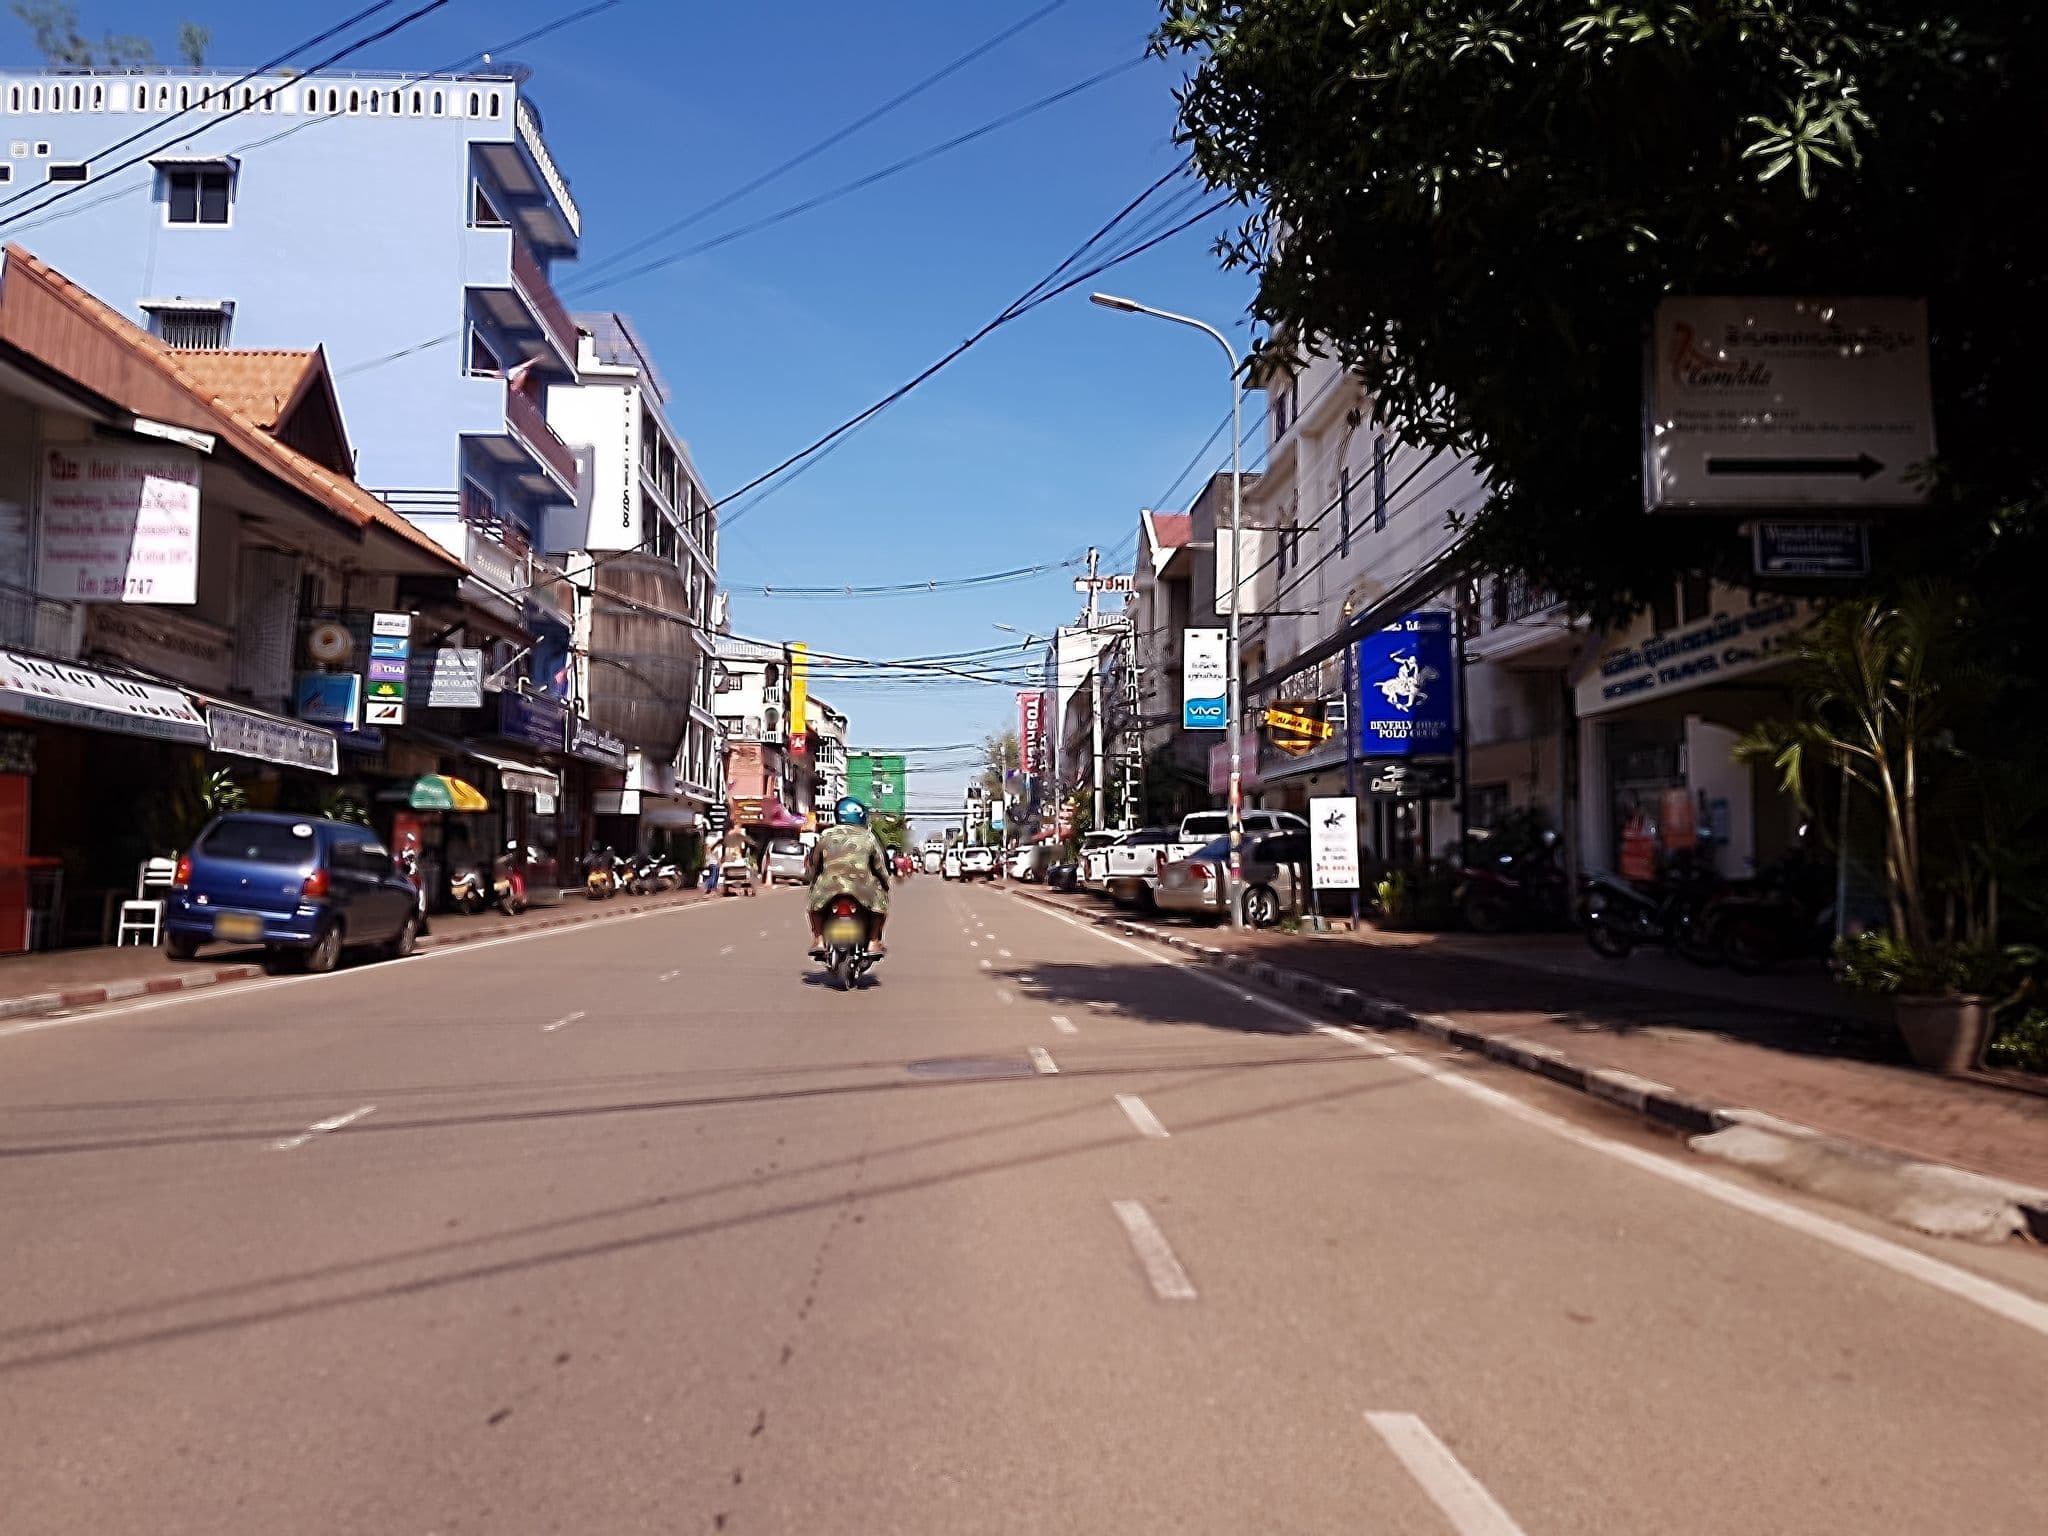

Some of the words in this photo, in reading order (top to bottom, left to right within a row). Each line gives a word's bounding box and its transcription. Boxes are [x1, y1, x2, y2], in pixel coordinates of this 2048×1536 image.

[7, 652, 96, 688] Sister
[383, 665, 405, 674] THAI
[1370, 720, 1413, 730] BEVERLY
[1379, 729, 1407, 738] POLO
